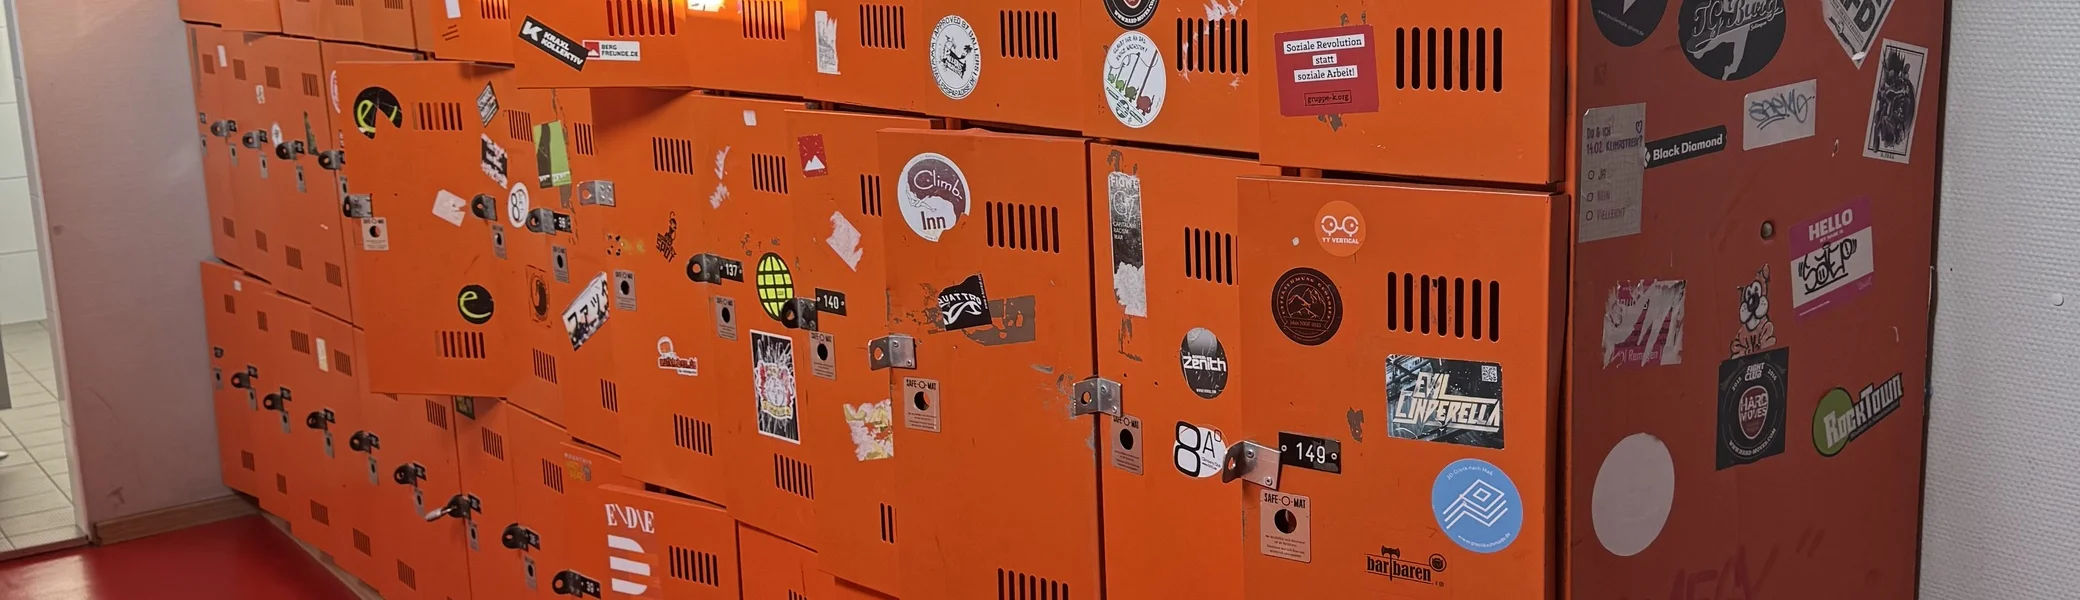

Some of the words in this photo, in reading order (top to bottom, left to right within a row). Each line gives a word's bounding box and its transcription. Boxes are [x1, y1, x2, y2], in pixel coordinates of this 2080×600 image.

[543, 31, 570, 51] KRAXL
[1286, 41, 1315, 52] Soziale
[1316, 38, 1362, 50] Revolution
[540, 39, 583, 65] KOLLEKTIV
[1315, 55, 1334, 65] statt
[1297, 69, 1325, 81] soziale
[1327, 66, 1351, 79] Arbeit!
[1307, 91, 1349, 104] gruppe-k.org
[1653, 145, 1680, 161] Black
[1681, 134, 1722, 154] Diamond
[920, 211, 946, 230] Inn
[1808, 208, 1854, 242] HELLO
[725, 263, 738, 277] 137
[823, 294, 839, 310] 140
[1182, 354, 1227, 372] Zenith
[1744, 370, 1763, 382] CLUB
[1740, 393, 1768, 412] HARD
[1393, 391, 1500, 433] CINDERELLA
[1740, 408, 1767, 422] MOVES
[1295, 441, 1326, 464] 149
[1263, 492, 1306, 509] SAFE-O-MAT
